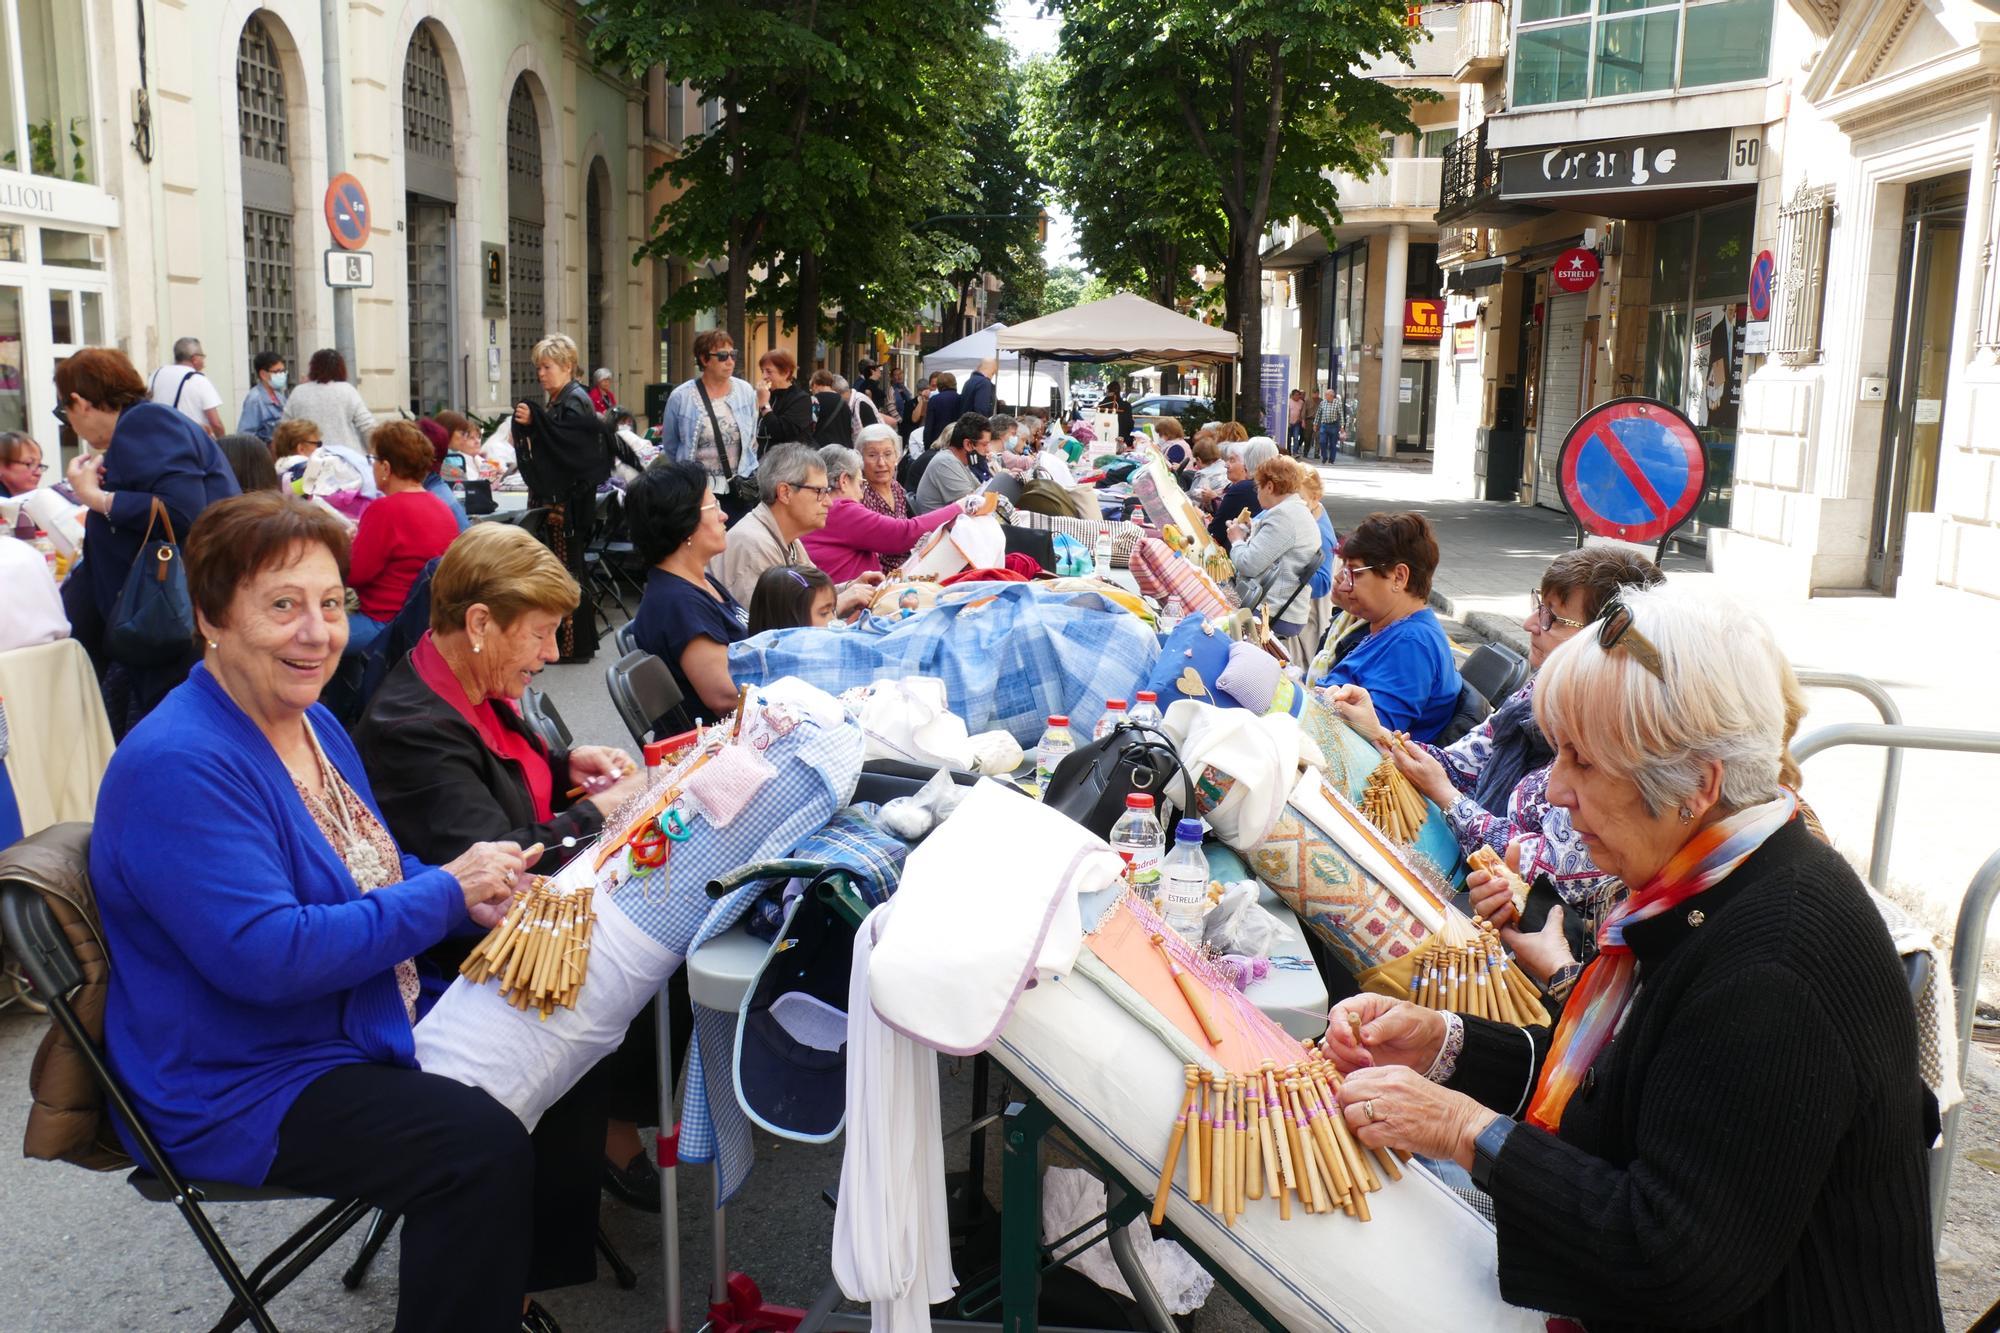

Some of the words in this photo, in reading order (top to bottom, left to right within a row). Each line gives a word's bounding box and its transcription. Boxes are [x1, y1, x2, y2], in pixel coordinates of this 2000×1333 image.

[1736, 138, 1760, 166] 50
[1558, 270, 1595, 278] ESTRELLA
[1405, 325, 1442, 334] TABACS
[1168, 894, 1199, 904] ESTRELLA
